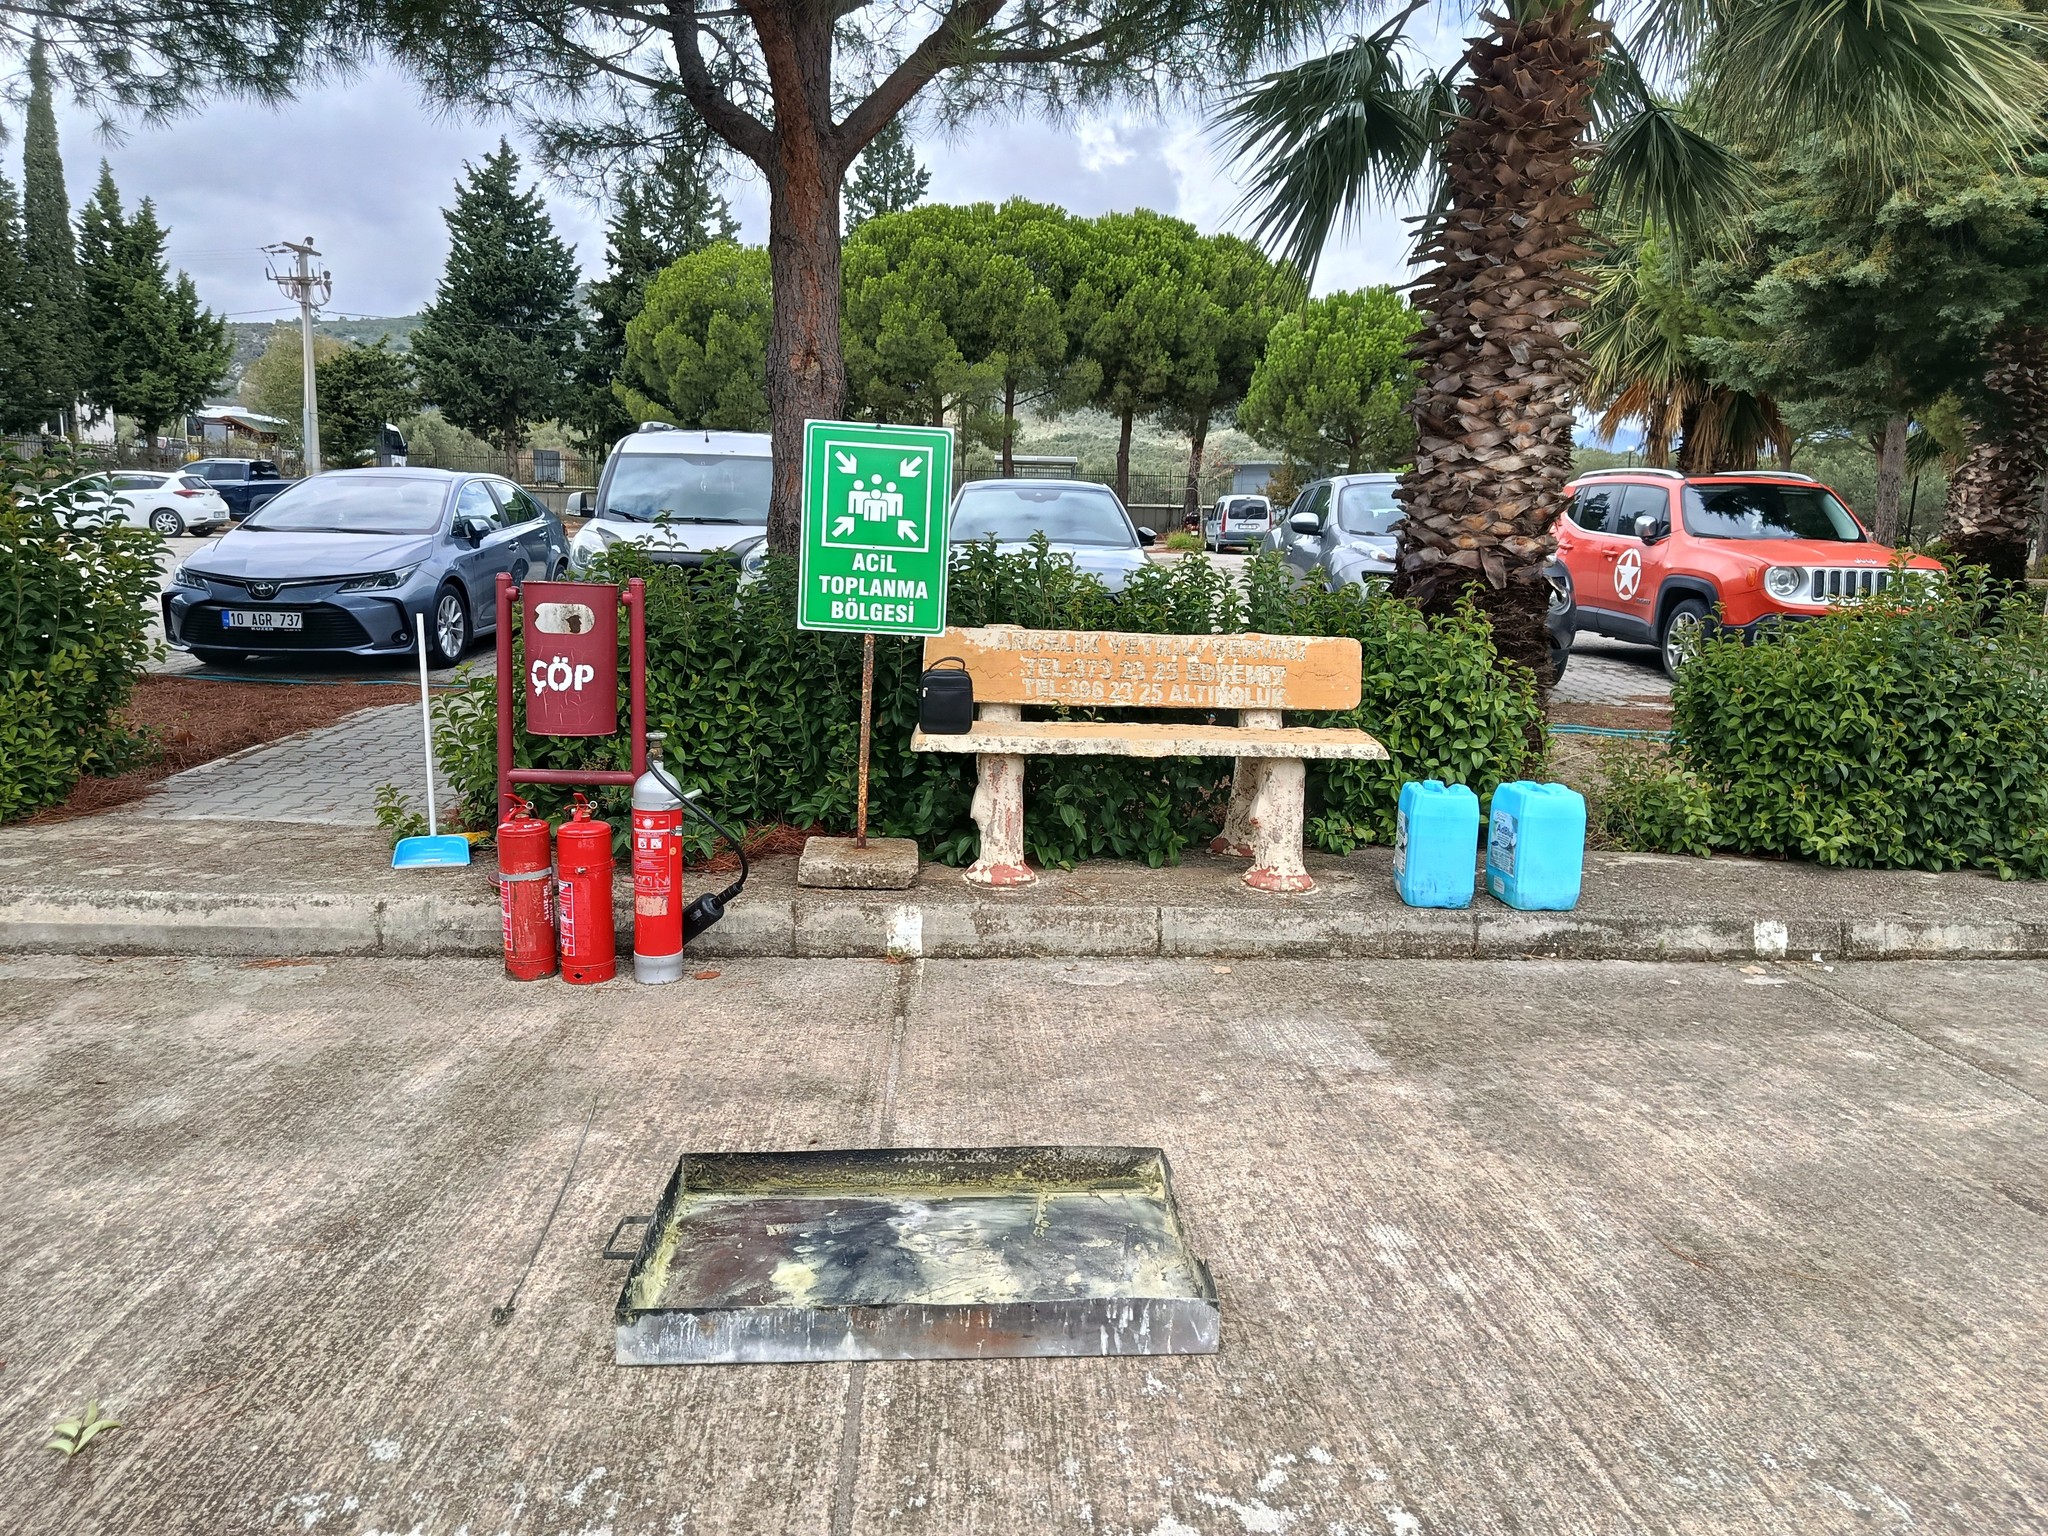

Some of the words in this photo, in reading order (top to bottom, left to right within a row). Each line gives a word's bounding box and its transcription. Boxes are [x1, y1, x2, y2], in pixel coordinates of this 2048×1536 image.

[819, 575, 928, 599] TOPLANMA
[231, 612, 244, 626] 10
[252, 613, 272, 626] AGR
[279, 614, 300, 627] 737
[831, 598, 914, 623] BÖLGESİ
[530, 655, 595, 697] ÇÖP
[1152, 661, 1179, 681] 25
[1109, 681, 1134, 700] 23
[1139, 682, 1163, 702] 25
[1169, 683, 1287, 707] ALTINOLUK
